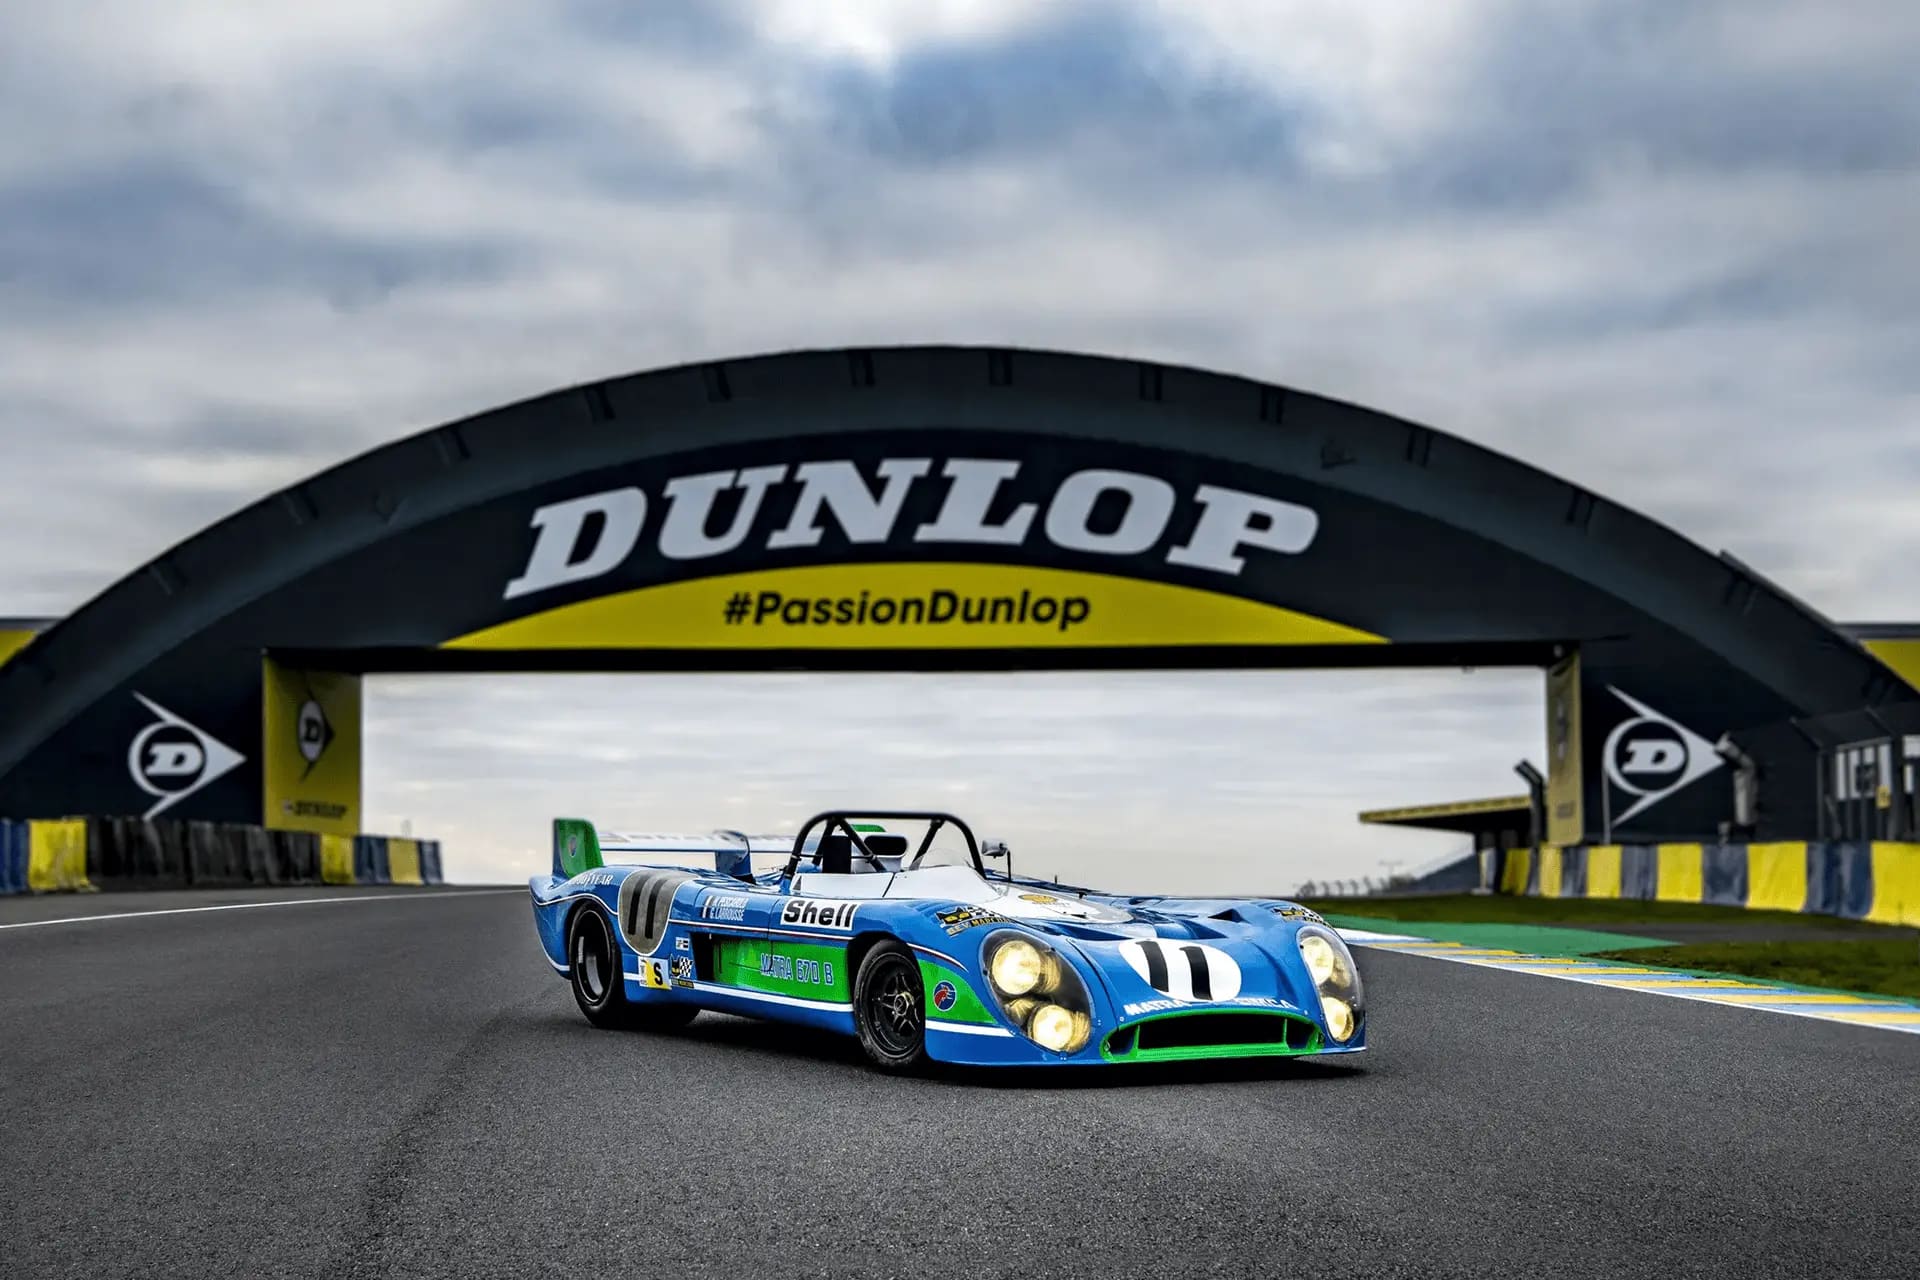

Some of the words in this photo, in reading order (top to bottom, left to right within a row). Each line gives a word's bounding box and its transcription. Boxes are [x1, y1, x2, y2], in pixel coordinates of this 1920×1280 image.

[504, 458, 1319, 599] DUNLOP
[724, 589, 1091, 632] #PassionDunlop
[144, 743, 203, 776] D
[1621, 739, 1687, 773] D
[627, 875, 669, 939] 11
[783, 900, 857, 928] Shell
[654, 962, 664, 986] S
[761, 953, 793, 980] MATRA
[797, 958, 820, 984] 670
[824, 962, 834, 986] B
[1135, 940, 1214, 1001] 11
